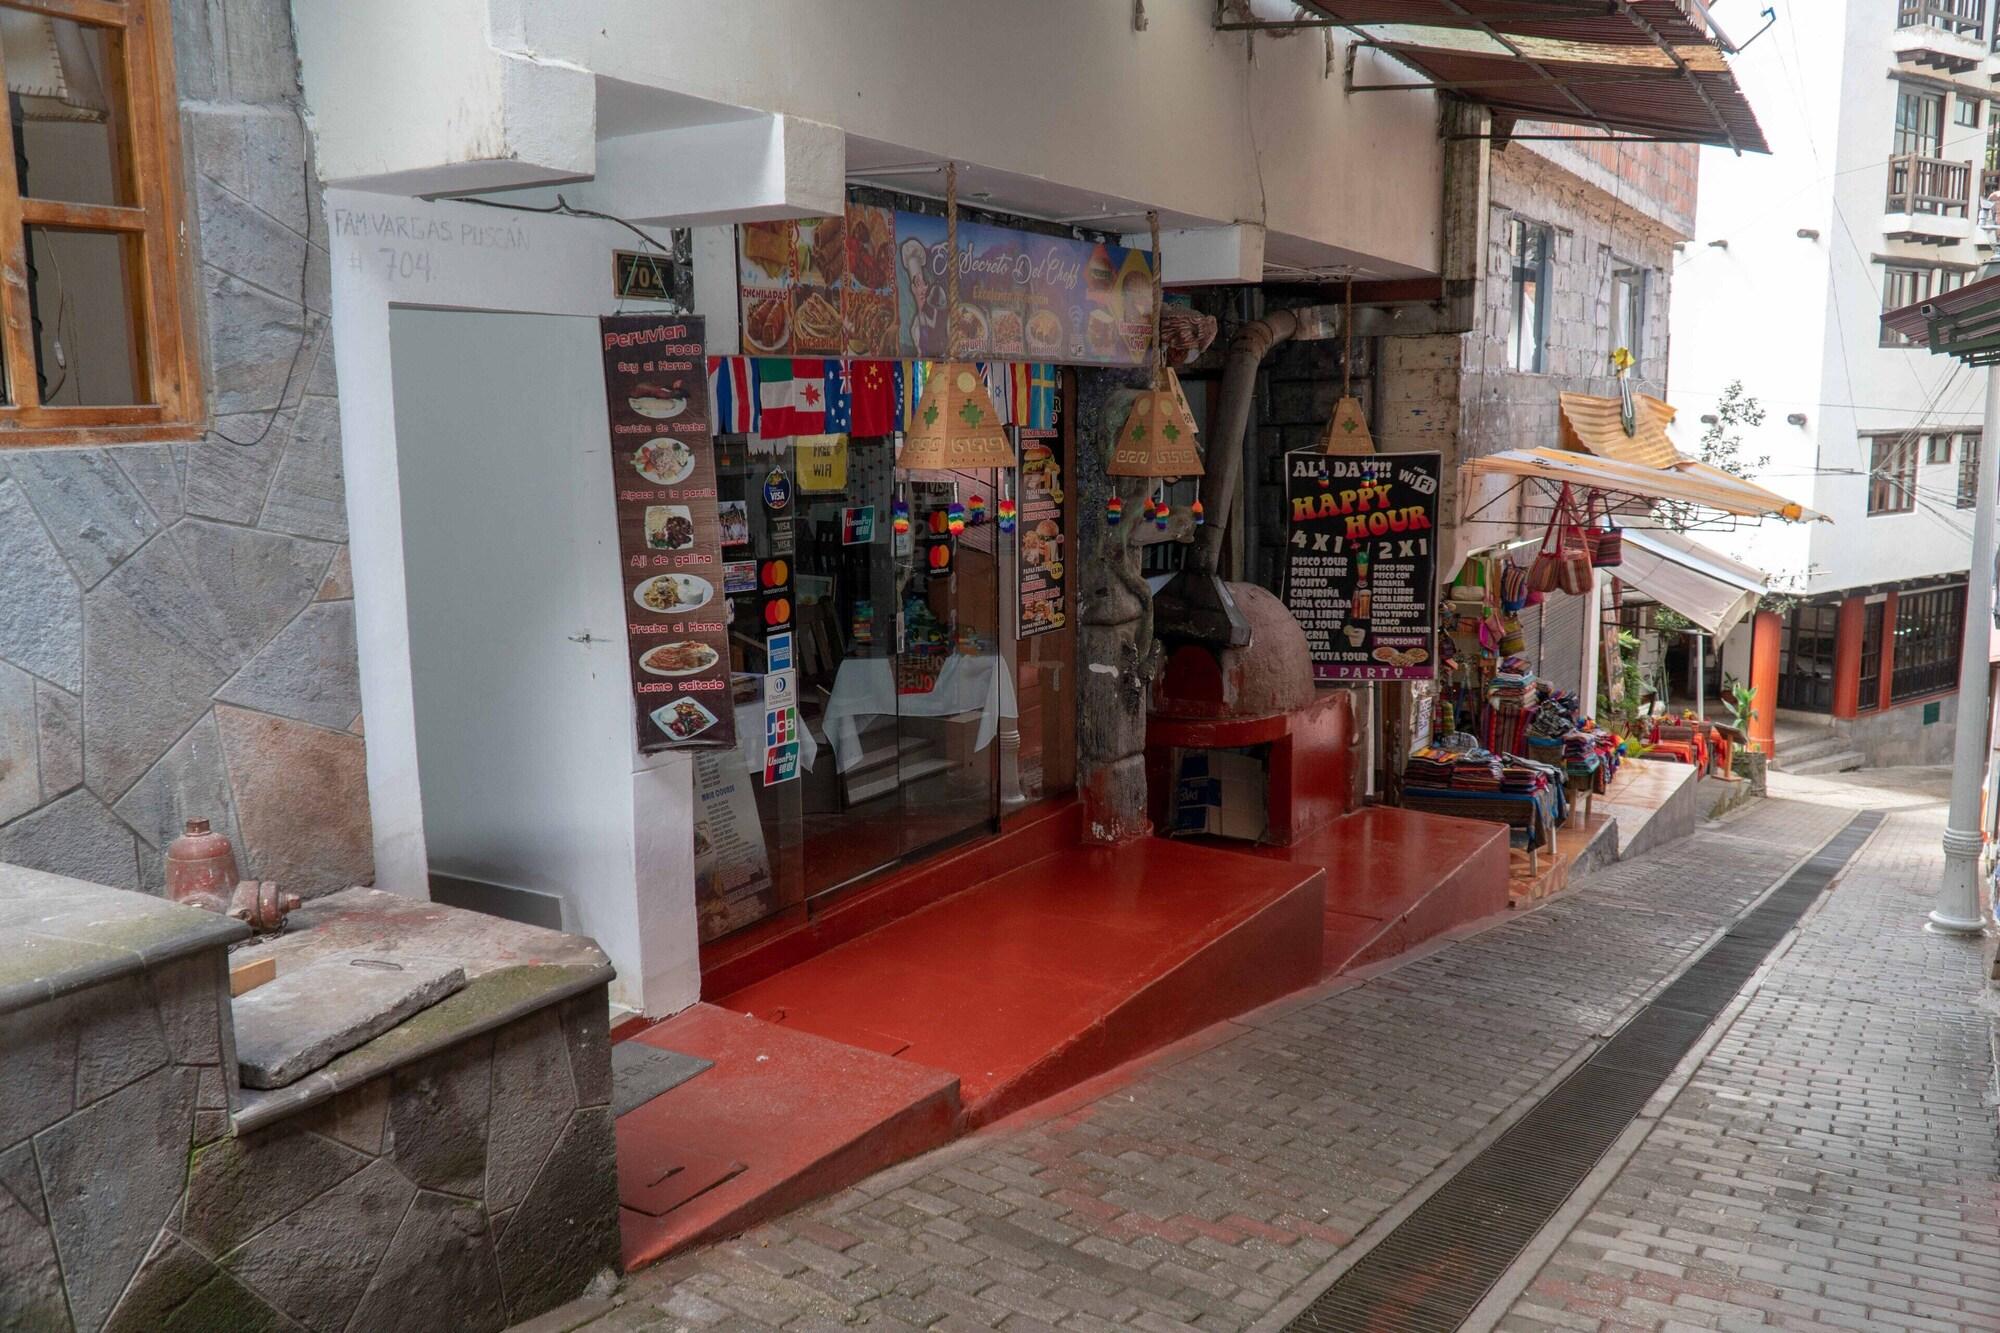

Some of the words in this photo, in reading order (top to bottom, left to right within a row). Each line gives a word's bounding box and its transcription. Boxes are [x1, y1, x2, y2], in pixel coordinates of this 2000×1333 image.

[370, 212, 453, 241] VARGAS
[958, 242, 1009, 280] Secreto
[1014, 253, 1042, 285] Del
[627, 265, 662, 289] 704
[742, 287, 788, 301] ENCHILADAS
[605, 324, 687, 350] Peruvian
[665, 343, 702, 356] FOOD
[643, 361, 654, 372] al
[659, 361, 693, 372] Horno
[656, 423, 669, 432] de
[672, 422, 706, 432] Trucha
[813, 463, 832, 478] WIFI
[621, 490, 653, 500] Alpaca
[657, 491, 665, 499] a
[669, 489, 679, 498] la
[769, 491, 785, 501] VISA
[1291, 484, 1393, 522] HAPPY
[776, 521, 791, 531] VISA
[1344, 505, 1432, 539] HOUR
[777, 540, 791, 550] VISA
[653, 553, 669, 566] de
[675, 552, 713, 567] gallina
[1291, 556, 1320, 567] PISCO
[1321, 556, 1348, 567] SOUR
[1291, 567, 1318, 577] PERU
[1319, 567, 1347, 577] LIBRE
[1373, 564, 1395, 572] PISCO
[1396, 564, 1415, 572] SOUR
[1291, 577, 1328, 587] MOJITO
[1373, 579, 1405, 587] NARANJA
[1373, 587, 1393, 595] PERU
[1393, 587, 1414, 595] LIBRE
[1290, 598, 1313, 609] PIÑA
[1314, 598, 1352, 609] COLADA
[1316, 609, 1345, 619] LIBRE
[629, 622, 668, 634] Trucha
[673, 622, 684, 633] al
[688, 621, 724, 633] Horno
[1315, 620, 1342, 629] SOUR
[1377, 637, 1422, 646] PORCIONES
[1341, 652, 1368, 661] SOUR
[637, 681, 673, 693] Lomo
[678, 680, 725, 692] saltado
[767, 718, 794, 736] JCB
[768, 751, 796, 767] UnionPay
